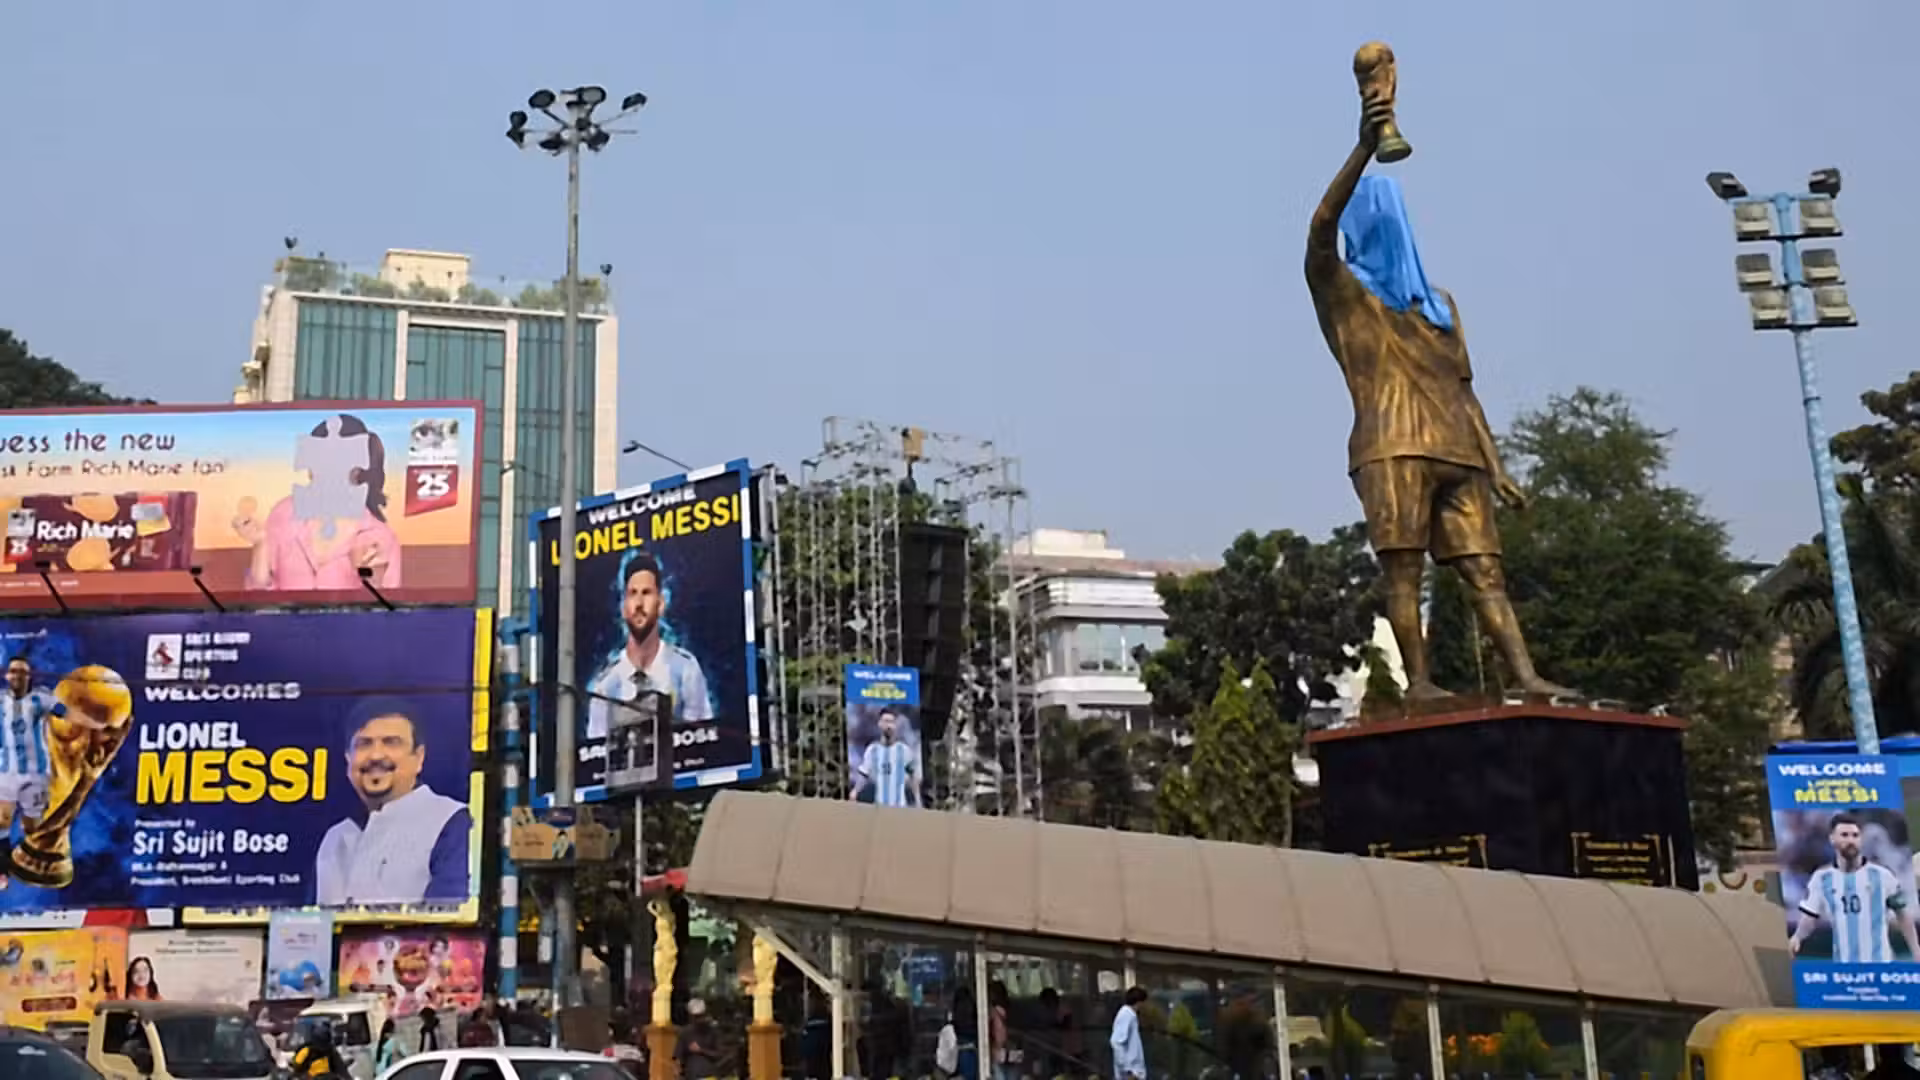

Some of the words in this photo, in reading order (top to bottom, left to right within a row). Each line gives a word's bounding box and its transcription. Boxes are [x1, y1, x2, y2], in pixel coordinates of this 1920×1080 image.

[65, 428, 107, 451] the
[120, 433, 175, 450] new
[27, 460, 73, 477] Farm
[82, 459, 121, 475] Rich
[128, 459, 183, 476] Marie
[417, 473, 450, 497] 25
[588, 484, 697, 524] WELCOME
[37, 520, 78, 541] Rich
[81, 519, 134, 540] Marie
[551, 519, 644, 566] LONEL
[651, 493, 742, 541] MESSI
[145, 682, 301, 701] WELCOMES
[139, 722, 246, 750] LIONEL
[136, 747, 328, 804] MESSI
[1778, 762, 1886, 776] WELCOME
[1794, 787, 1879, 803] MESSI
[133, 830, 164, 855] Sri
[173, 829, 225, 859] Sujit
[233, 828, 289, 853] Bose
[1841, 895, 1861, 914] 10
[1803, 972, 1828, 984] SRI
[1832, 972, 1875, 984] SUJIT
